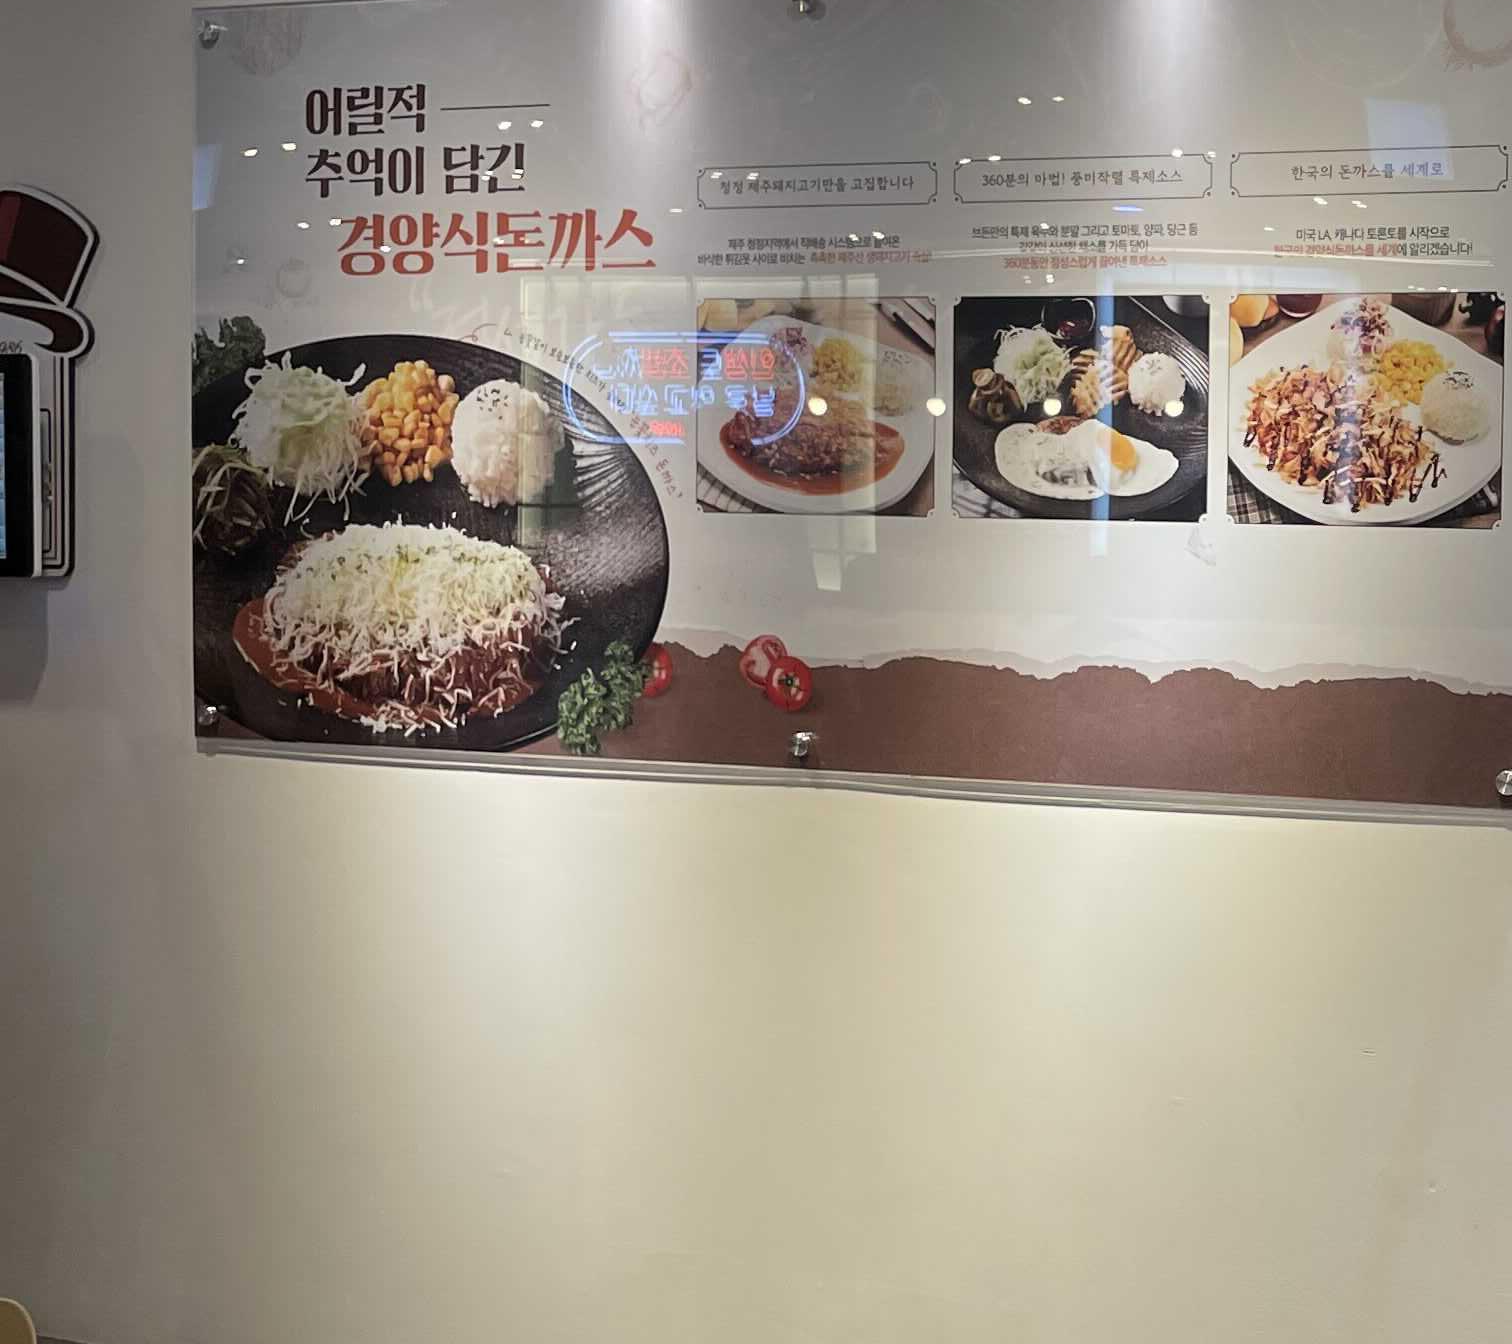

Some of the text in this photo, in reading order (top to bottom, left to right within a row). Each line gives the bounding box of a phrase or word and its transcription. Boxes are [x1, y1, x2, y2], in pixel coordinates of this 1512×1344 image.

[305, 84, 427, 137] 어릴적
[305, 142, 526, 198] 추억이 담긴
[981, 173, 1030, 187] 360분의
[1033, 172, 1066, 187] 마법!
[1127, 168, 1184, 184] 특제소스
[1290, 160, 1445, 181] 한국의 돈까스를 세계로
[851, 174, 915, 191] 고집합니다
[337, 207, 658, 277] 경양식돈까스
[1296, 228, 1316, 242] 미국
